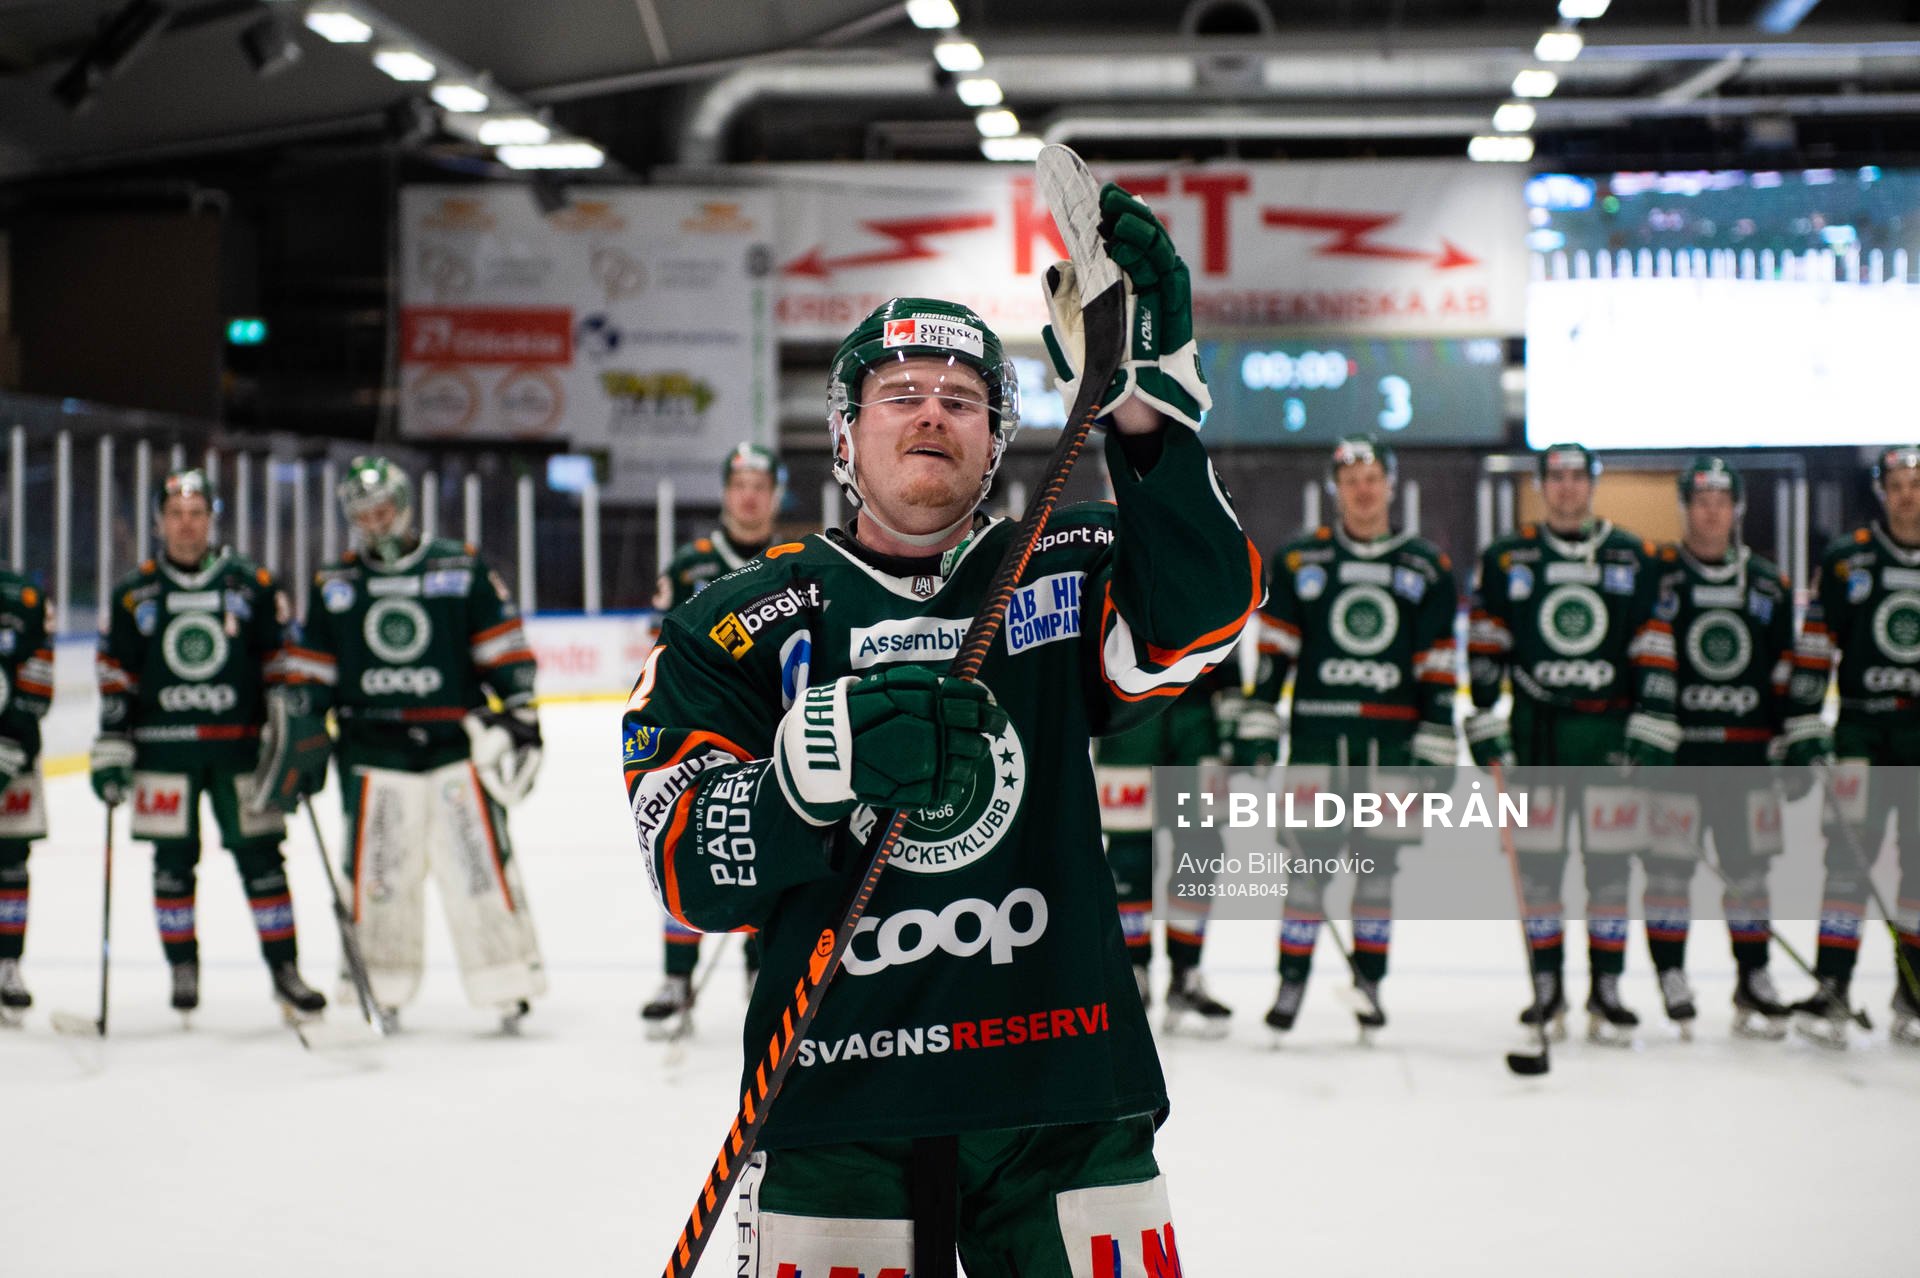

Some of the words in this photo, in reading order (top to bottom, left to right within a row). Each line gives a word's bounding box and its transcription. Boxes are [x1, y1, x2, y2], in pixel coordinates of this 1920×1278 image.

[1010, 173, 1252, 277] KT
[911, 312, 966, 324] WARRIOR
[920, 323, 982, 345] SVENSKA
[920, 333, 954, 347] SPEL
[1378, 375, 1412, 430] 3
[1008, 588, 1037, 625] AB
[134, 787, 181, 815] LM
[841, 887, 1049, 976] coop
